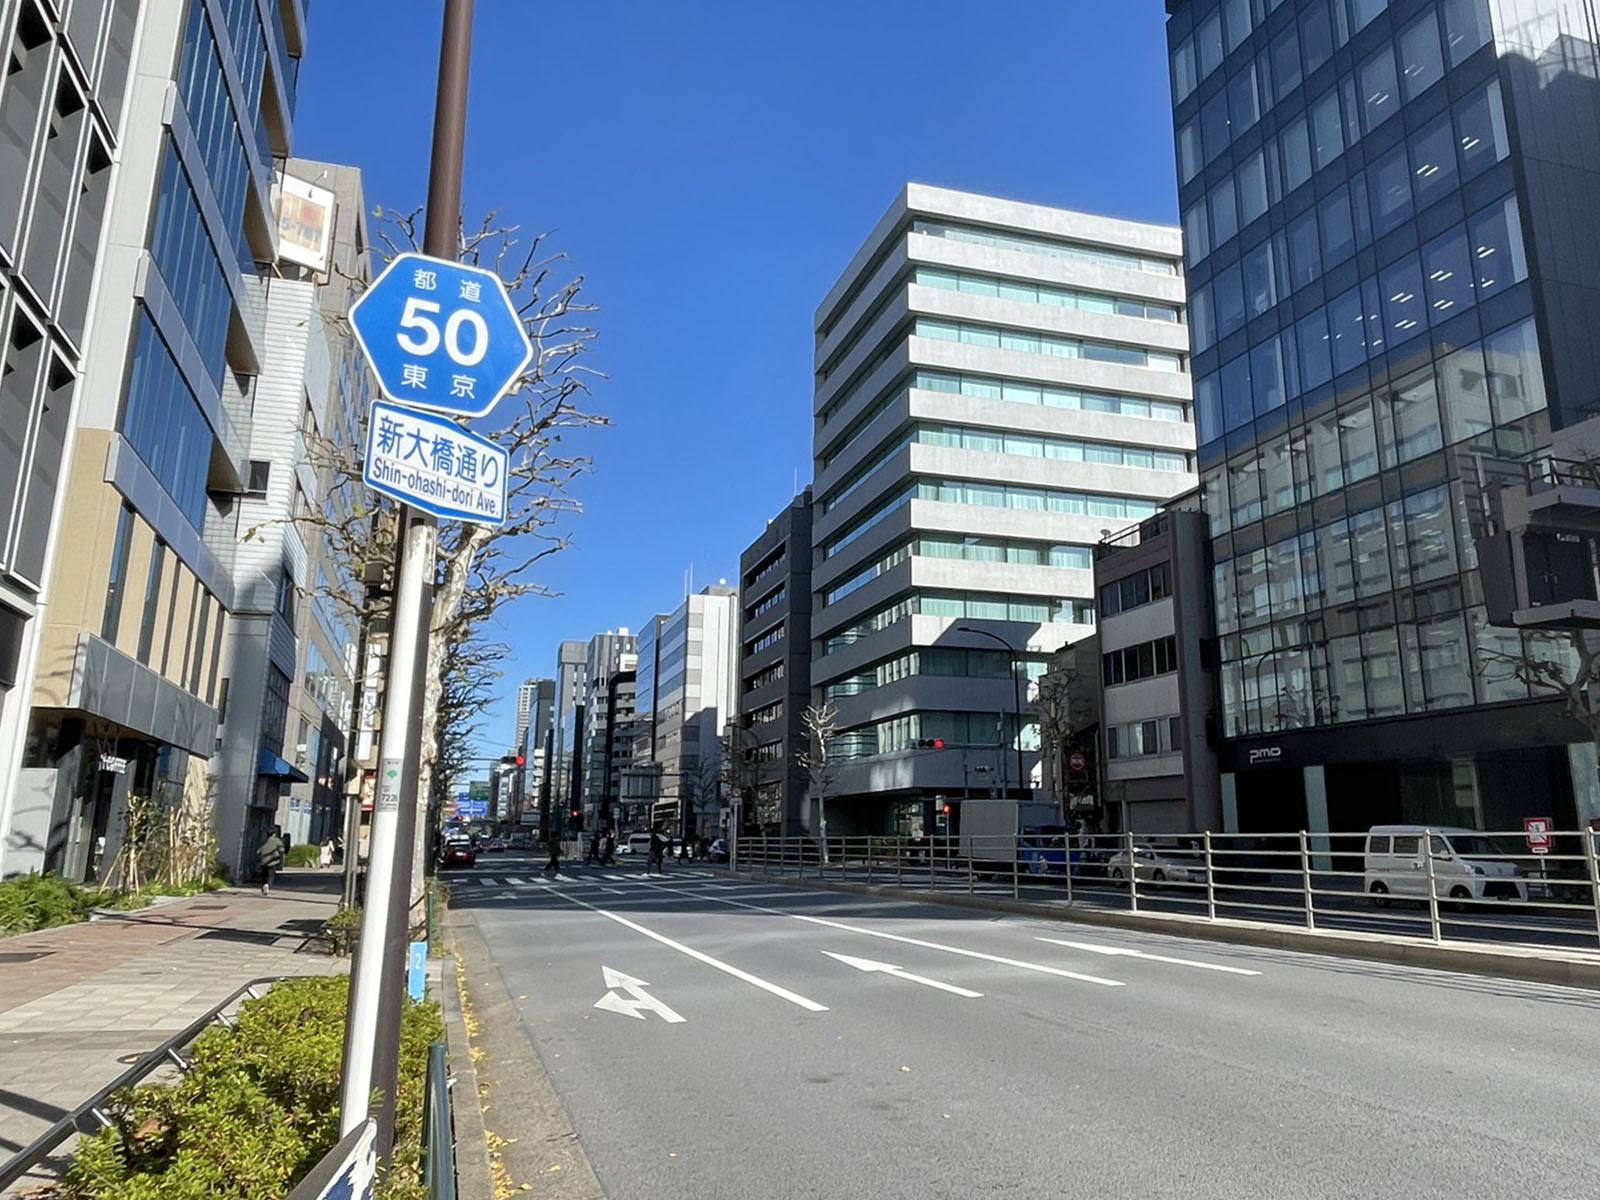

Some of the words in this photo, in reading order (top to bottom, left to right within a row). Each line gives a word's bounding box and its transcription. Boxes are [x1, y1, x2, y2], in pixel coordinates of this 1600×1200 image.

[396, 297, 488, 367] 50
[377, 415, 499, 489] 新大橋通り
[373, 457, 474, 508] Shin-ohashi-dori
[476, 491, 499, 516] Ave.
[1249, 746, 1281, 764] pmo
[414, 951, 422, 970] 2
